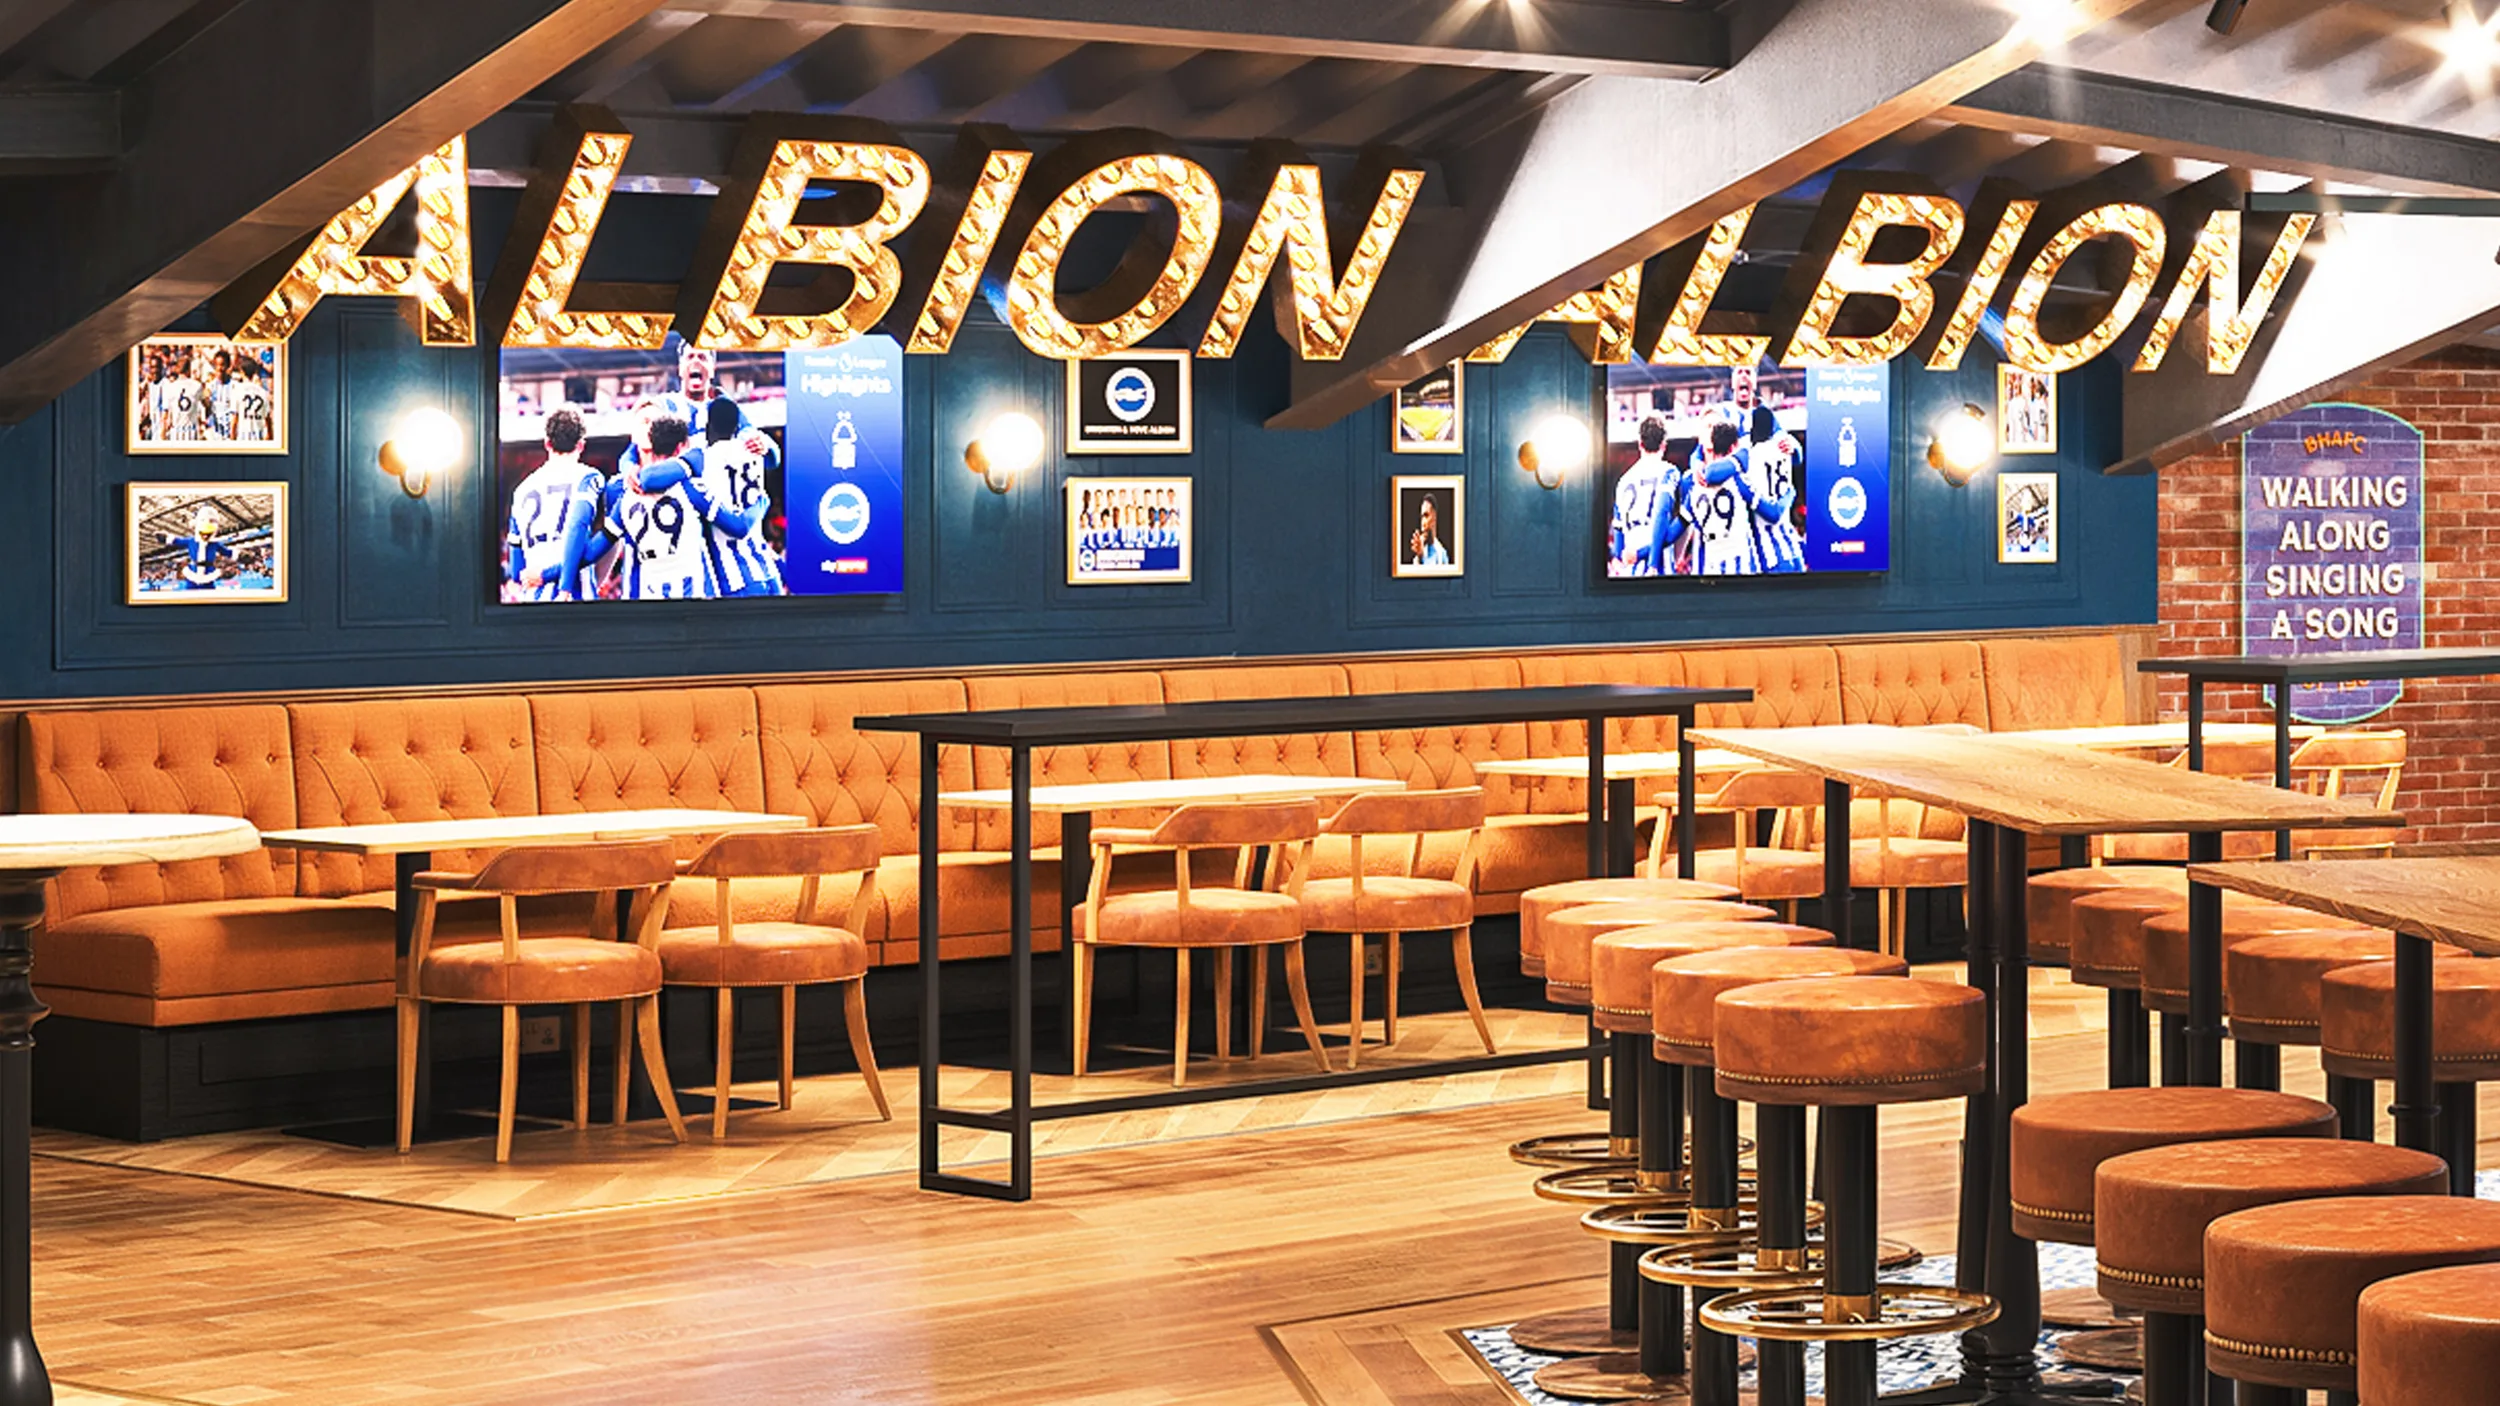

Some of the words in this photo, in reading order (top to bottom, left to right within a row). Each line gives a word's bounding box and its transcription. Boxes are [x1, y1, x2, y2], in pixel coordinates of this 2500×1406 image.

[230, 131, 1426, 362] ALBION
[177, 387, 192, 413] 6
[2304, 430, 2368, 454] BHAFC
[724, 460, 761, 514] 18
[2261, 476, 2408, 509] WALKING
[522, 483, 573, 549] 27
[628, 496, 684, 558] 29
[2279, 519, 2391, 552] ALONG
[2265, 563, 2405, 597] SINGING
[2270, 609, 2294, 640] A
[2305, 606, 2399, 641] SONG
